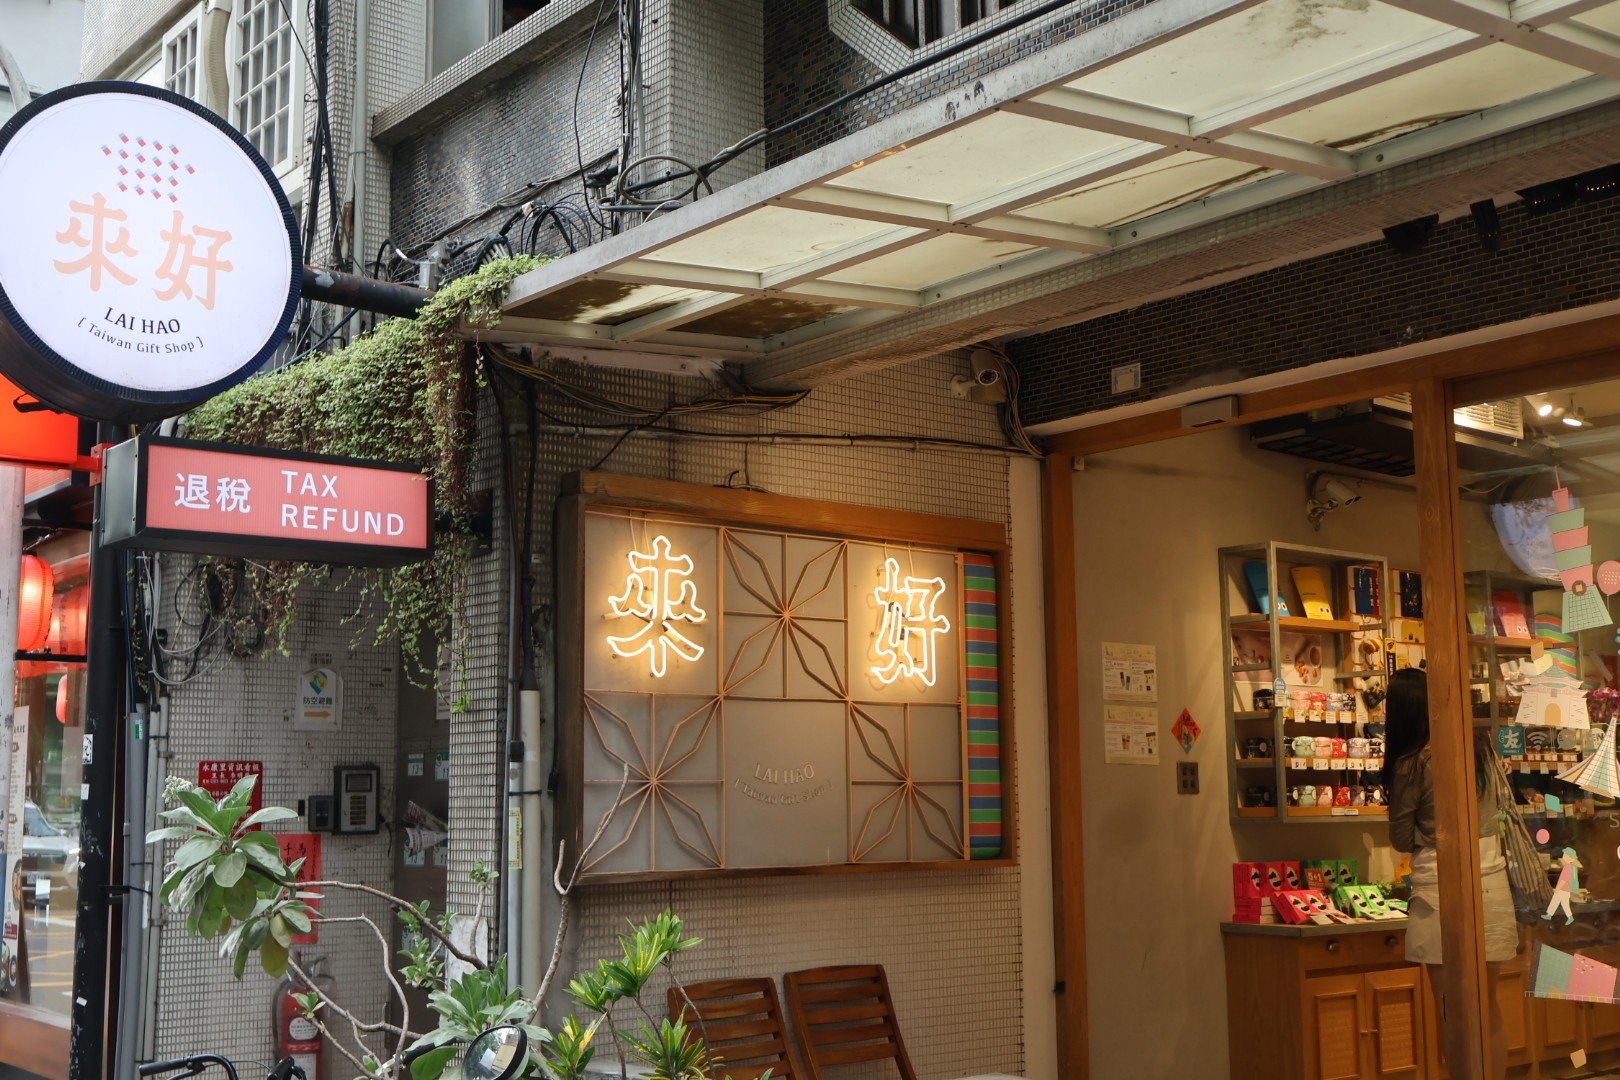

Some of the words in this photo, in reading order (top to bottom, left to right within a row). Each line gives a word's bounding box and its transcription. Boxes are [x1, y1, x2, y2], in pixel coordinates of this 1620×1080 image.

[53, 192, 234, 310] 來好
[104, 307, 135, 330] LAI
[141, 318, 181, 334] HAO
[136, 342, 161, 353] Gift
[174, 473, 251, 514] 退稅
[281, 470, 338, 498] TAX
[281, 503, 404, 536] REFUND
[606, 535, 706, 678] 來
[871, 557, 951, 687] 好
[1503, 729, 1522, 749] 友
[753, 762, 779, 784] LAI
[783, 762, 815, 784] HAO
